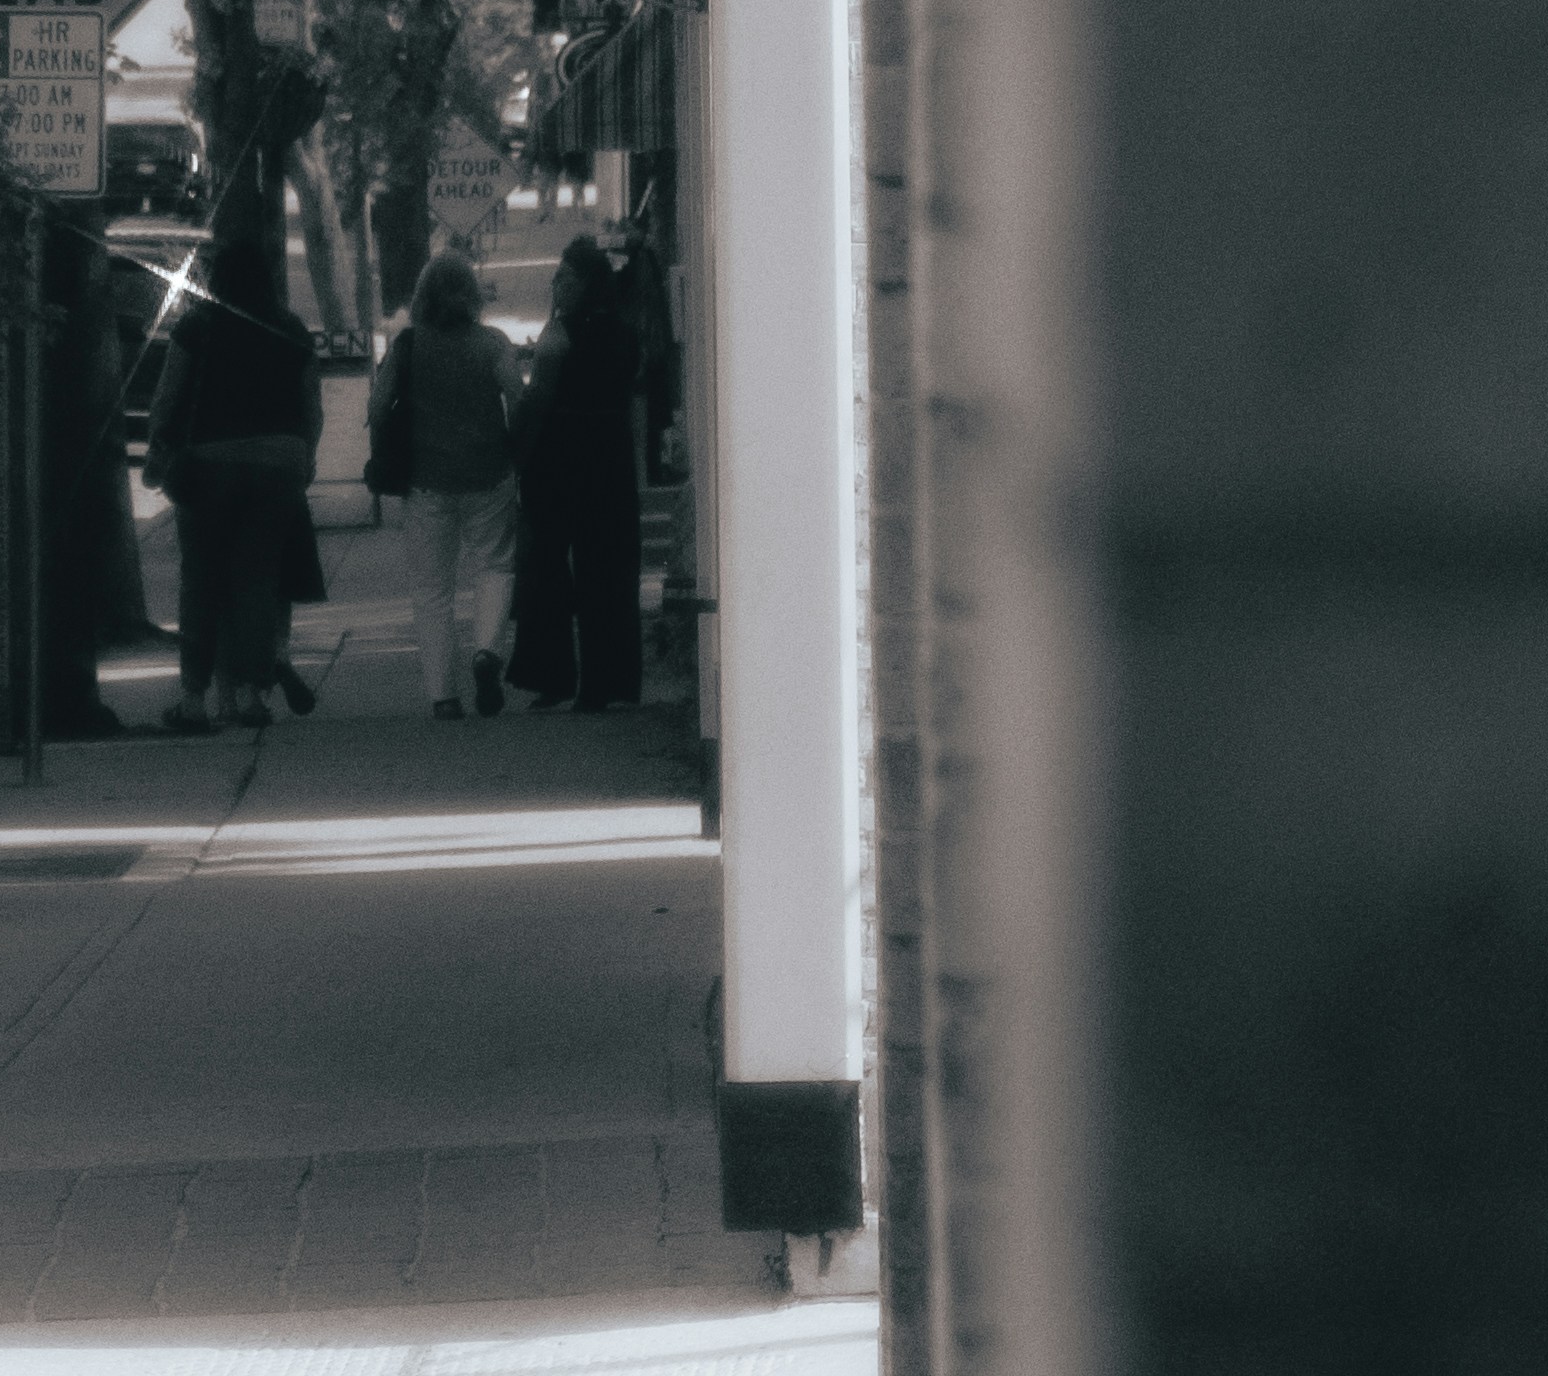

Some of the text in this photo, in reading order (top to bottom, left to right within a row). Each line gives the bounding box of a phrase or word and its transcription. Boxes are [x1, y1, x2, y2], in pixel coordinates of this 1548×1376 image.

[37, 20, 70, 44] HR
[12, 48, 96, 73] PARKING
[47, 85, 73, 107] AM
[62, 112, 87, 135] PM
[35, 142, 85, 159] SUNDAY
[427, 158, 502, 179] DETOUR
[434, 181, 494, 199] AHEAD
[310, 331, 369, 356] PEN
